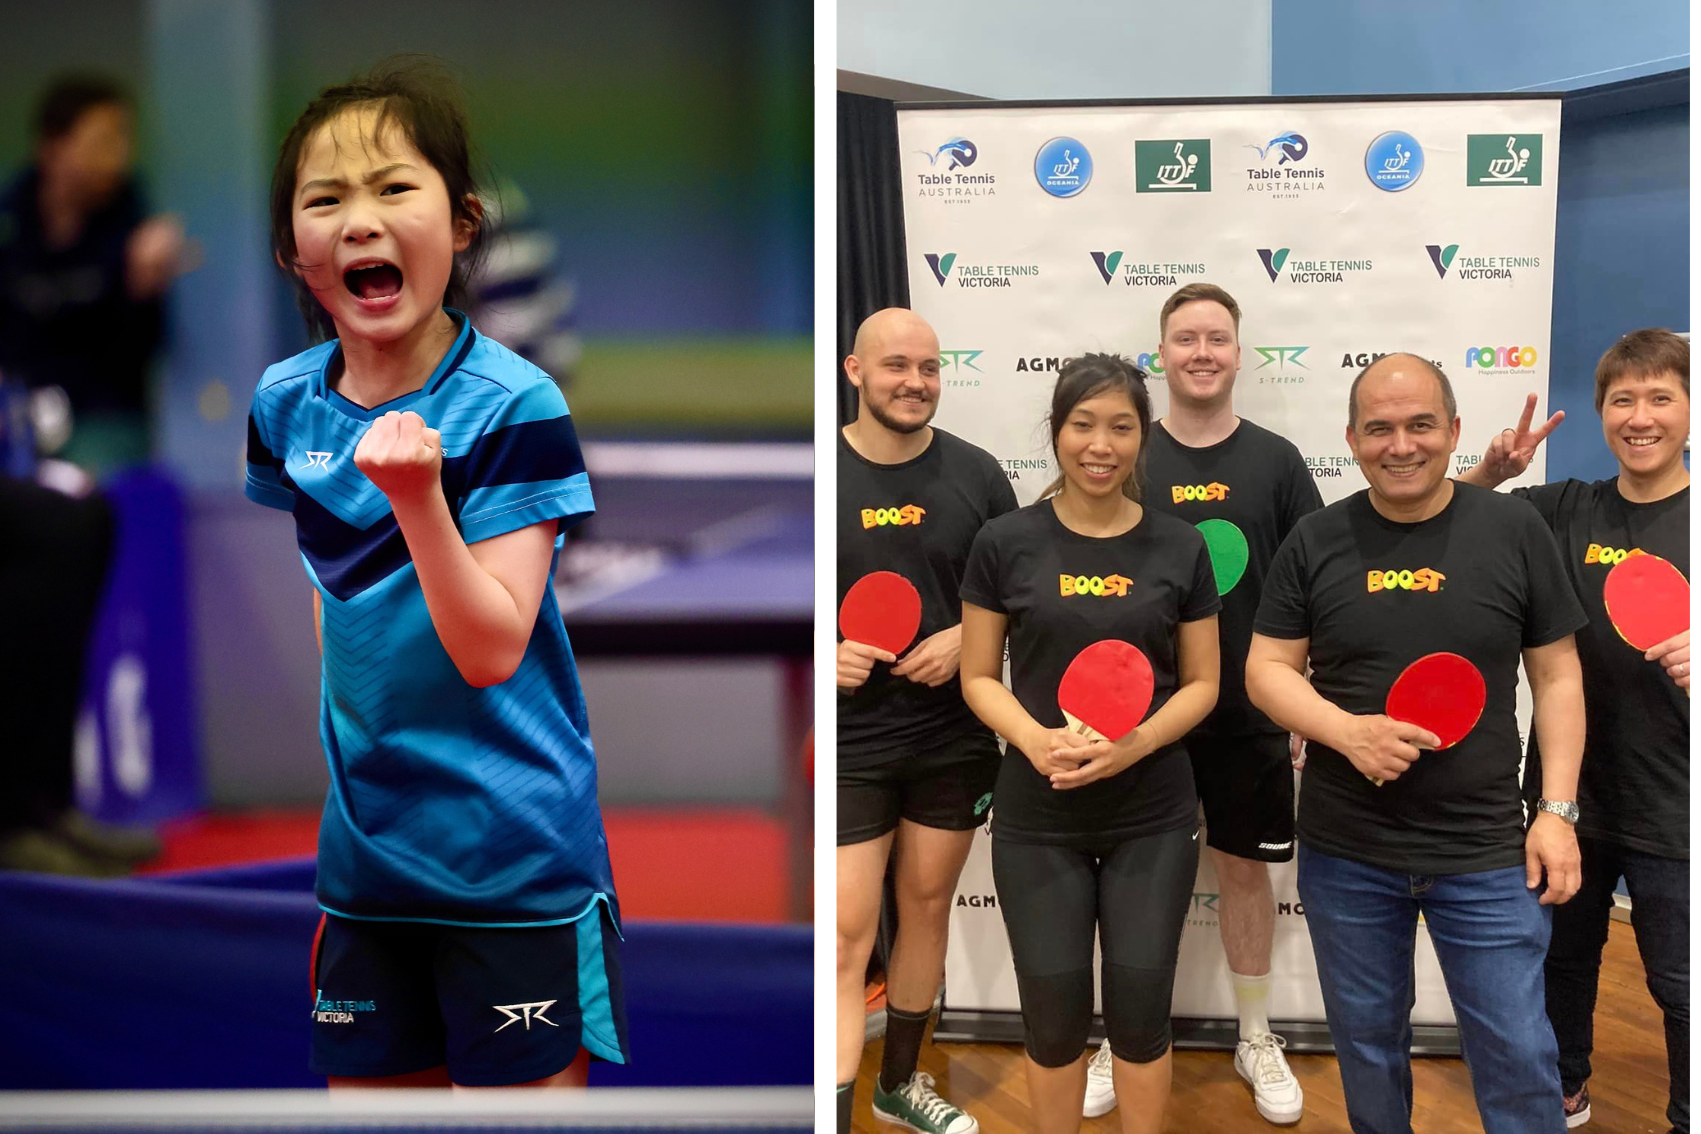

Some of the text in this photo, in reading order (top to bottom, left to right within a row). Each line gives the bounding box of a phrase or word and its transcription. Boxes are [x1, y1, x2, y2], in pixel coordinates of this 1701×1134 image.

[918, 173, 995, 185] Table Tennis
[1247, 167, 1325, 179] Table Tennis
[919, 187, 996, 197] AUSTRALIA
[1247, 181, 1325, 192] AUSTRALIA
[1290, 259, 1372, 272] TABLE TENNIS
[1459, 256, 1540, 268] TABLE TENNIS
[958, 264, 1039, 277] TABLE TENNIS
[1124, 262, 1205, 275] TABLE TENNIS
[1459, 268, 1512, 280] VICTORIA
[958, 276, 1011, 288] VICTORIA
[1124, 275, 1177, 286] VICTORIA
[1290, 271, 1343, 283] VICTORIA
[1465, 346, 1538, 368] PONGO
[1005, 459, 1047, 469] TENNIS
[1305, 456, 1360, 467] BLE TENN
[1308, 467, 1342, 478] TORIA
[1171, 482, 1230, 504] BOOST
[861, 504, 926, 530] BOOST
[1584, 543, 1645, 566] BOO
[1059, 573, 1134, 598] BOOST
[1366, 567, 1446, 593] BOOST
[316, 1011, 354, 1023] VICTORIA
